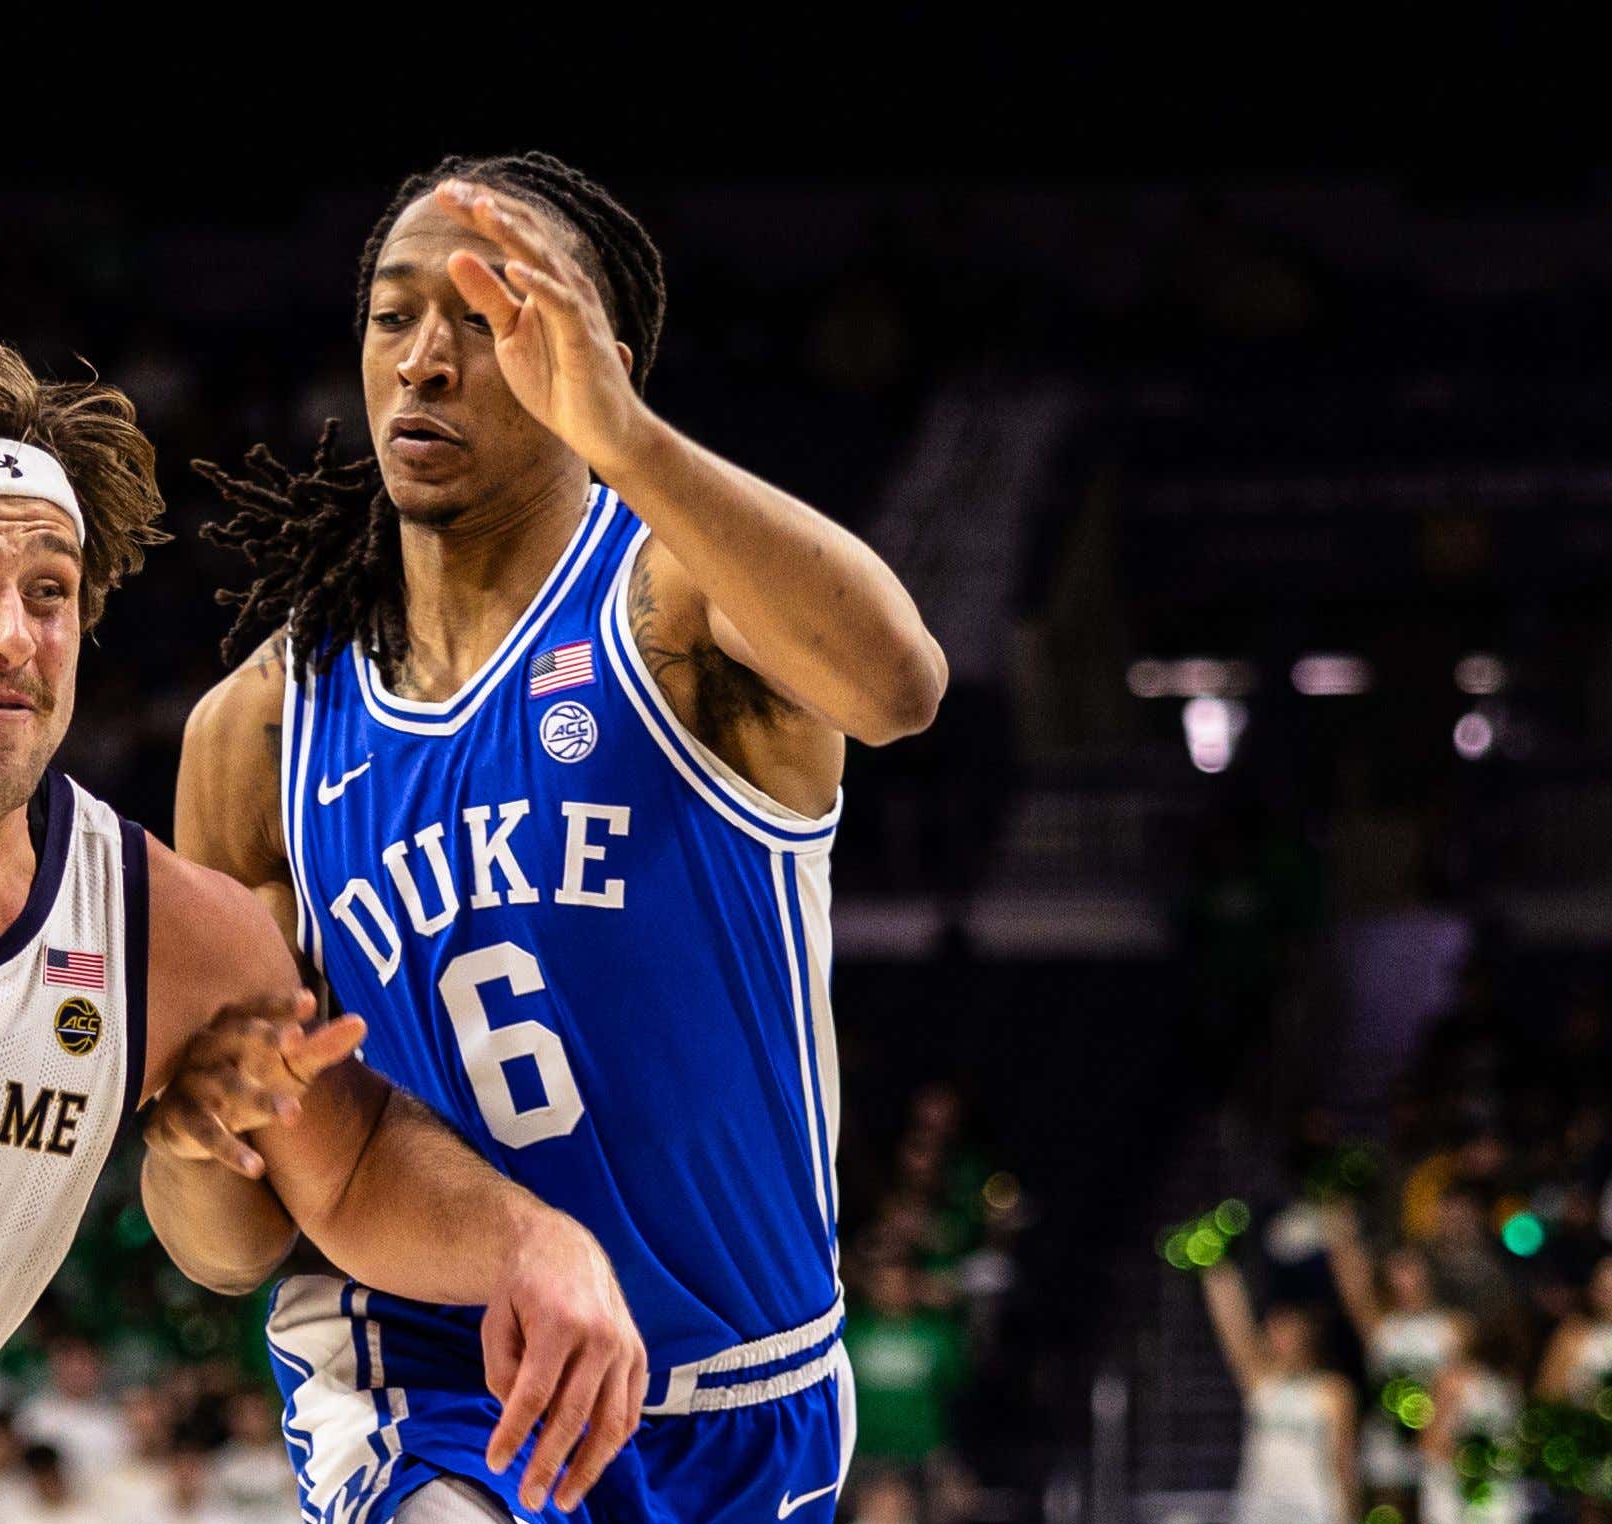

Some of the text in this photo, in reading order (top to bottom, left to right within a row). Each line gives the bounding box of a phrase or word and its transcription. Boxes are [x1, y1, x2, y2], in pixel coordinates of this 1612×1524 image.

[551, 719, 590, 737] ACC
[329, 798, 631, 988] DUKE
[62, 1015, 101, 1032] ACC
[438, 940, 585, 1150] 6
